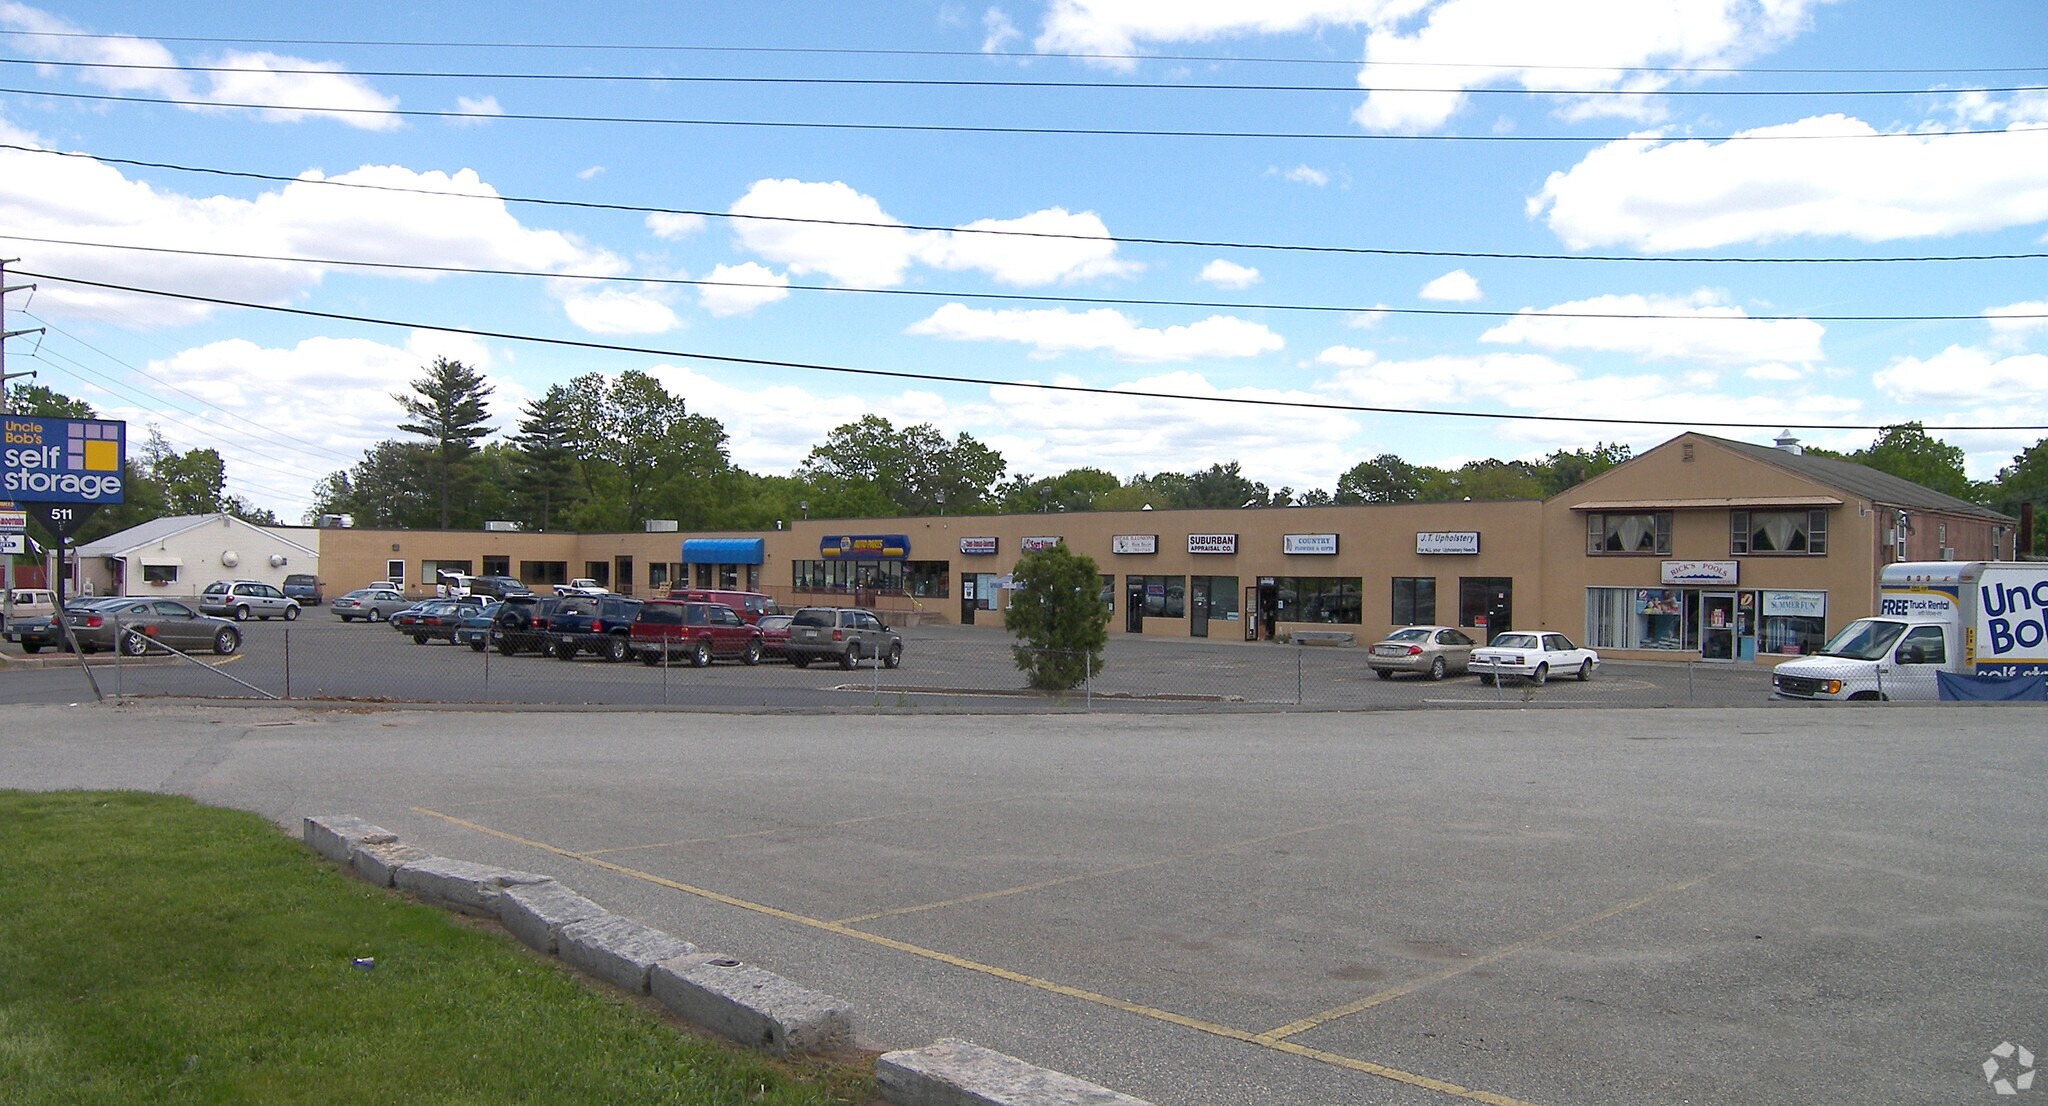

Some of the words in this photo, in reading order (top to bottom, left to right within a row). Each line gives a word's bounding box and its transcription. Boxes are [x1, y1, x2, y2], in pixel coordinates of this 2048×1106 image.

[5, 421, 43, 433] Uncle
[5, 433, 42, 445] Bob's
[4, 446, 61, 469] self
[4, 468, 121, 500] storage
[51, 508, 72, 520] 511
[1190, 536, 1233, 545] SUBURBAN
[1434, 534, 1475, 543] Upholstery
[1670, 563, 1696, 576] RICK'S
[1702, 563, 1729, 577] POOLS
[1881, 599, 1908, 615] FREE
[1910, 600, 1926, 610] Truck
[1928, 600, 1949, 610] Rental
[1988, 607, 2048, 655] Bo
